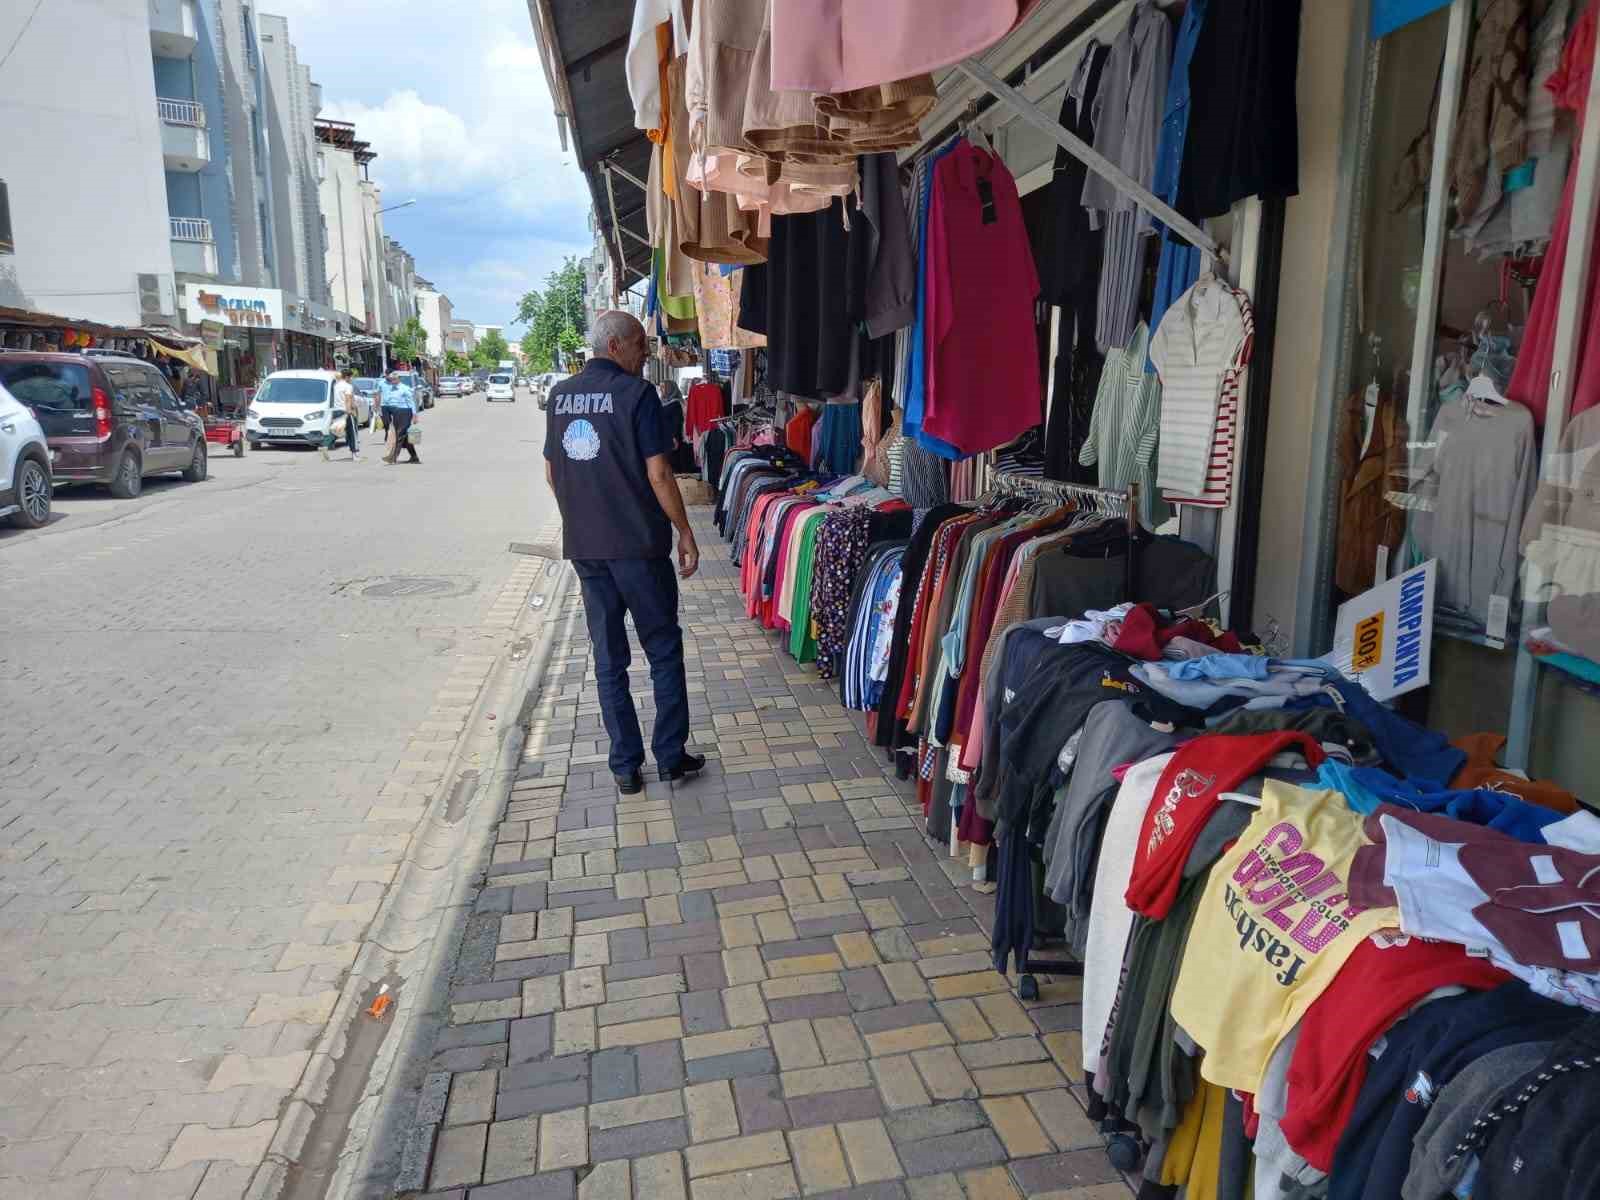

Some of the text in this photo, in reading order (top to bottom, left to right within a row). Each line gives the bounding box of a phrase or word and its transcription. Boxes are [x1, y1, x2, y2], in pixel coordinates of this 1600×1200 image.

[554, 393, 614, 415] ZABITA
[1392, 569, 1427, 688] KAMPANYA
[1311, 900, 1350, 931] COLOR
